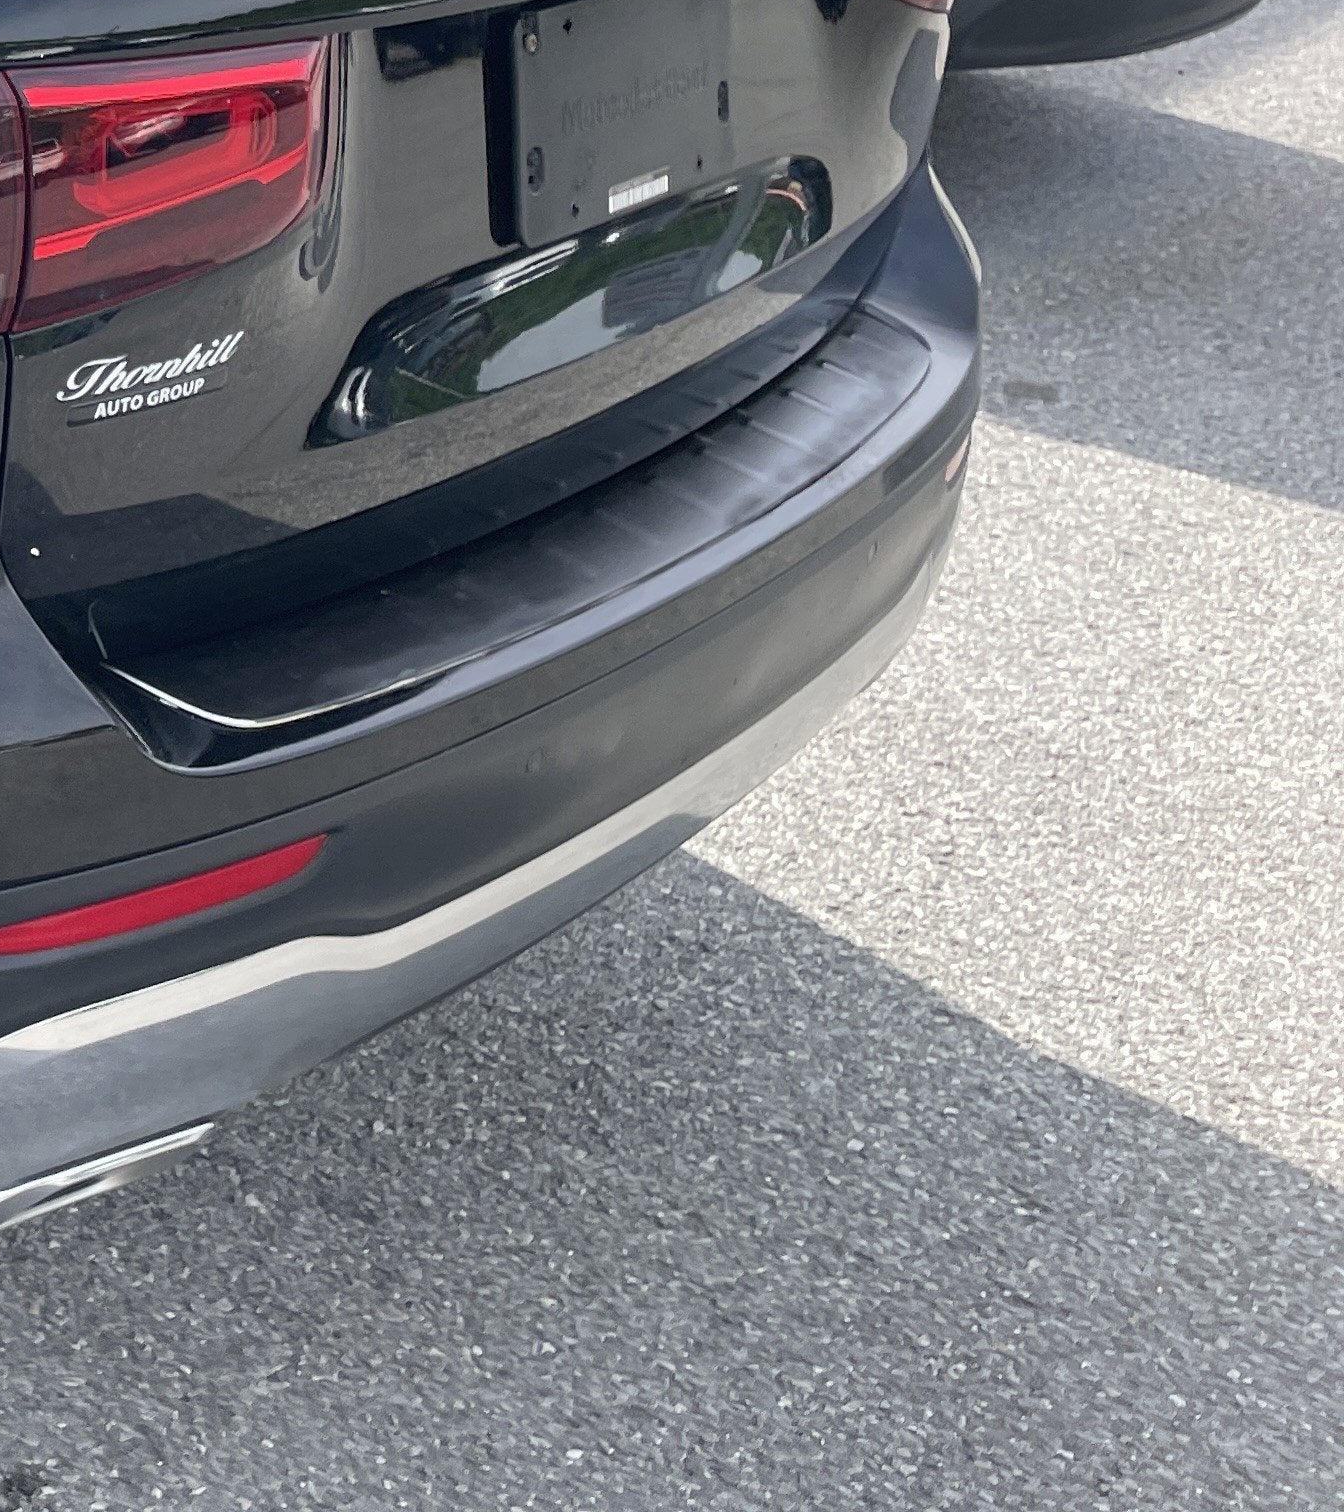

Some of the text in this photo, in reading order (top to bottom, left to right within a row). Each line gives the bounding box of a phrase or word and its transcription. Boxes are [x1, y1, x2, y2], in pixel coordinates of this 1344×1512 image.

[56, 330, 245, 402] Thornhill
[93, 377, 206, 420] AUTO GROUP
